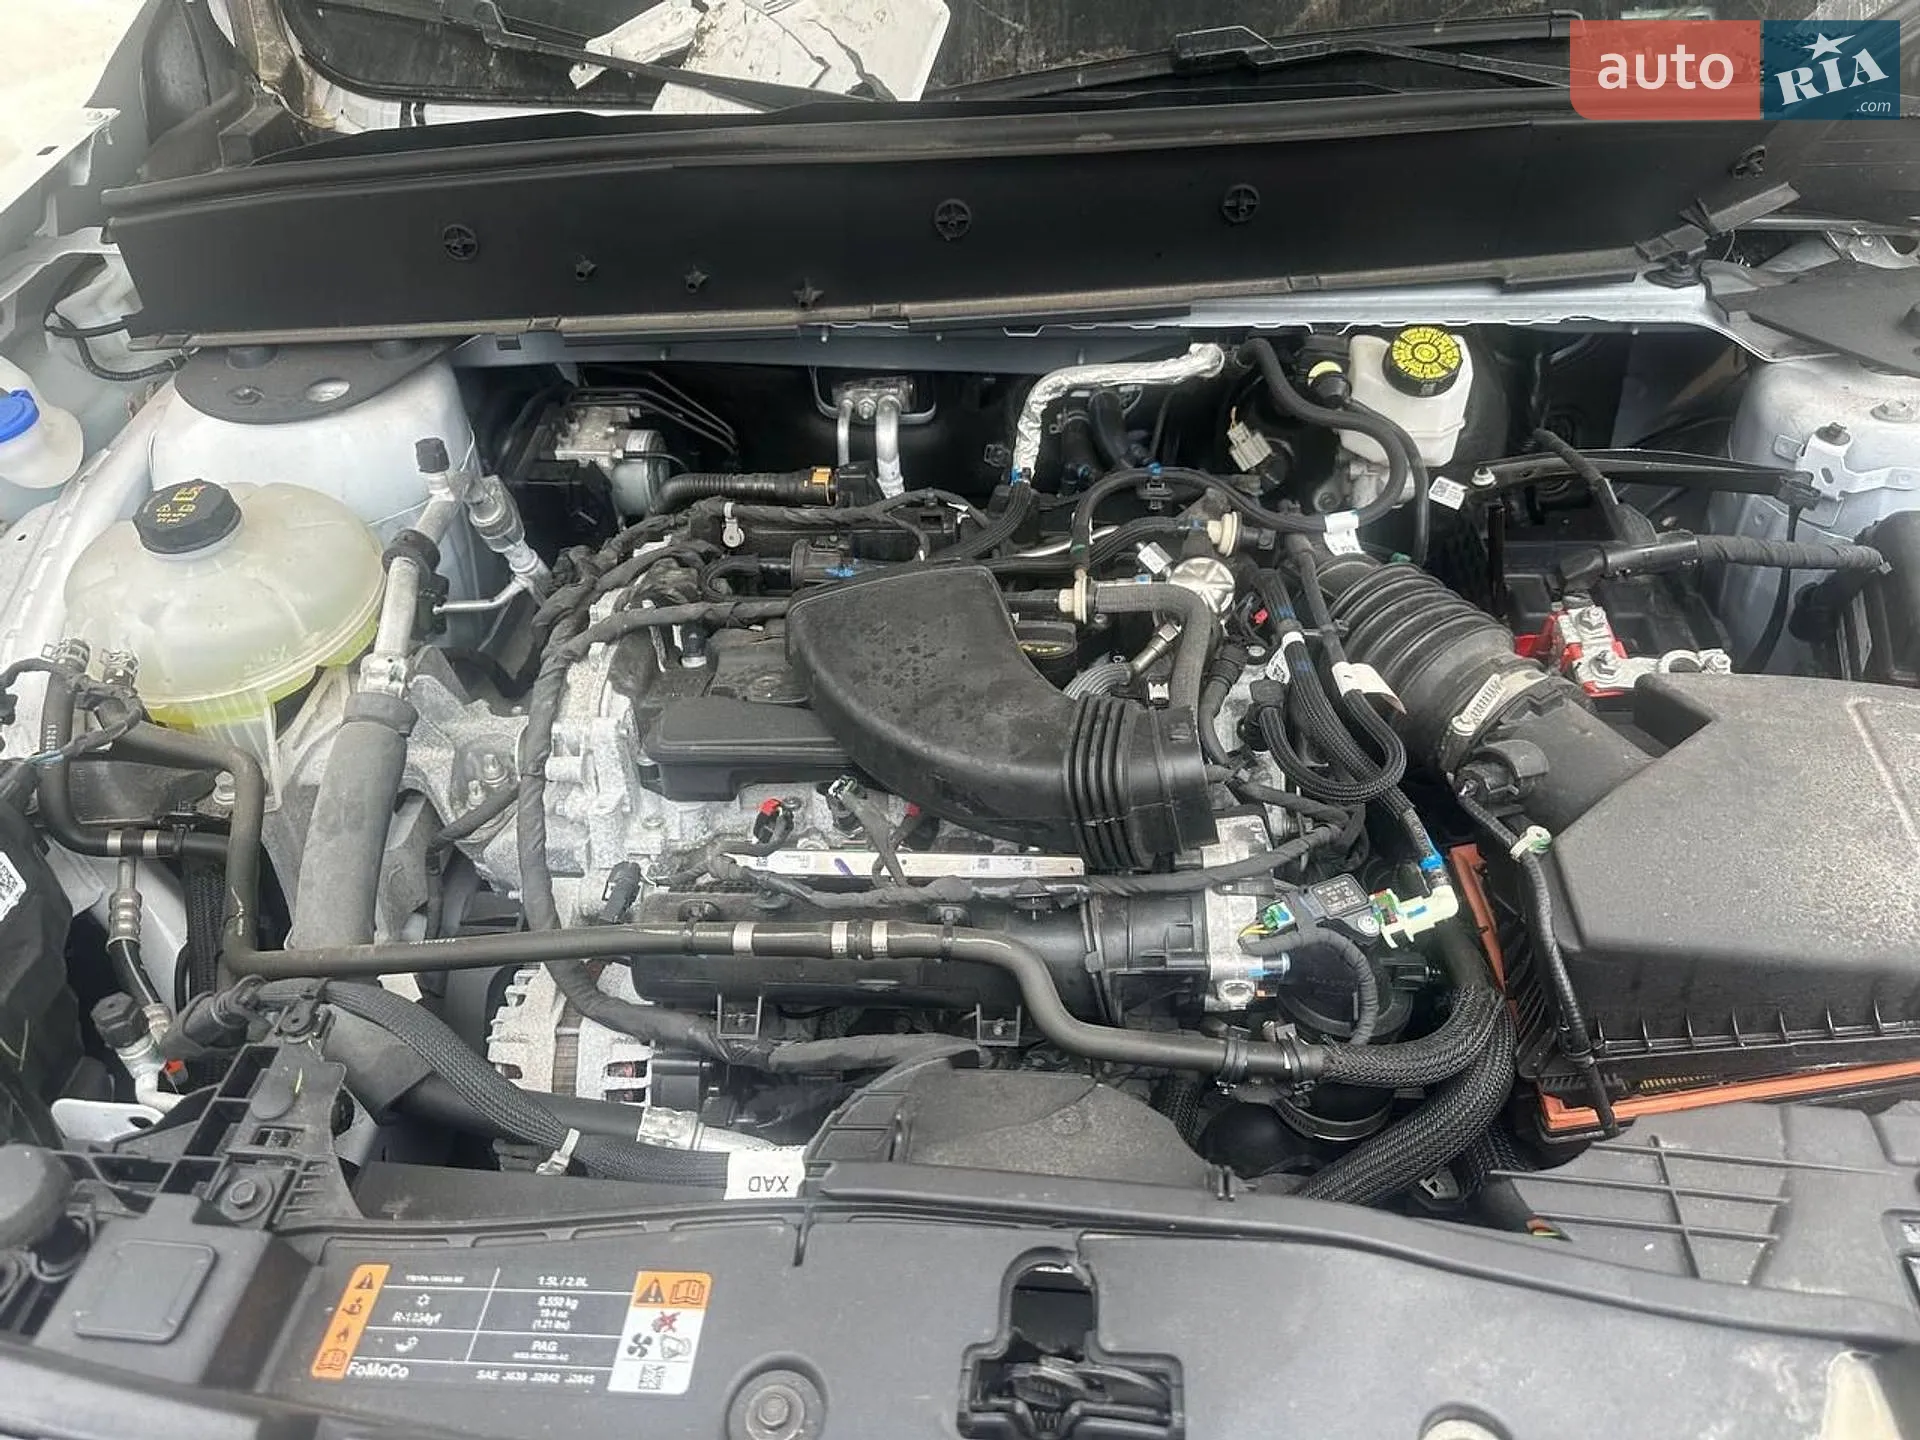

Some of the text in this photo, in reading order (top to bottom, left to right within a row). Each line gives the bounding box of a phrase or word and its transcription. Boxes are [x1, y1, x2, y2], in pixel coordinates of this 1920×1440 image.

[748, 1175, 789, 1193] XAD
[531, 1340, 558, 1352] PAG
[346, 1361, 410, 1379] FoMoCo
[475, 1369, 501, 1380] SAE
